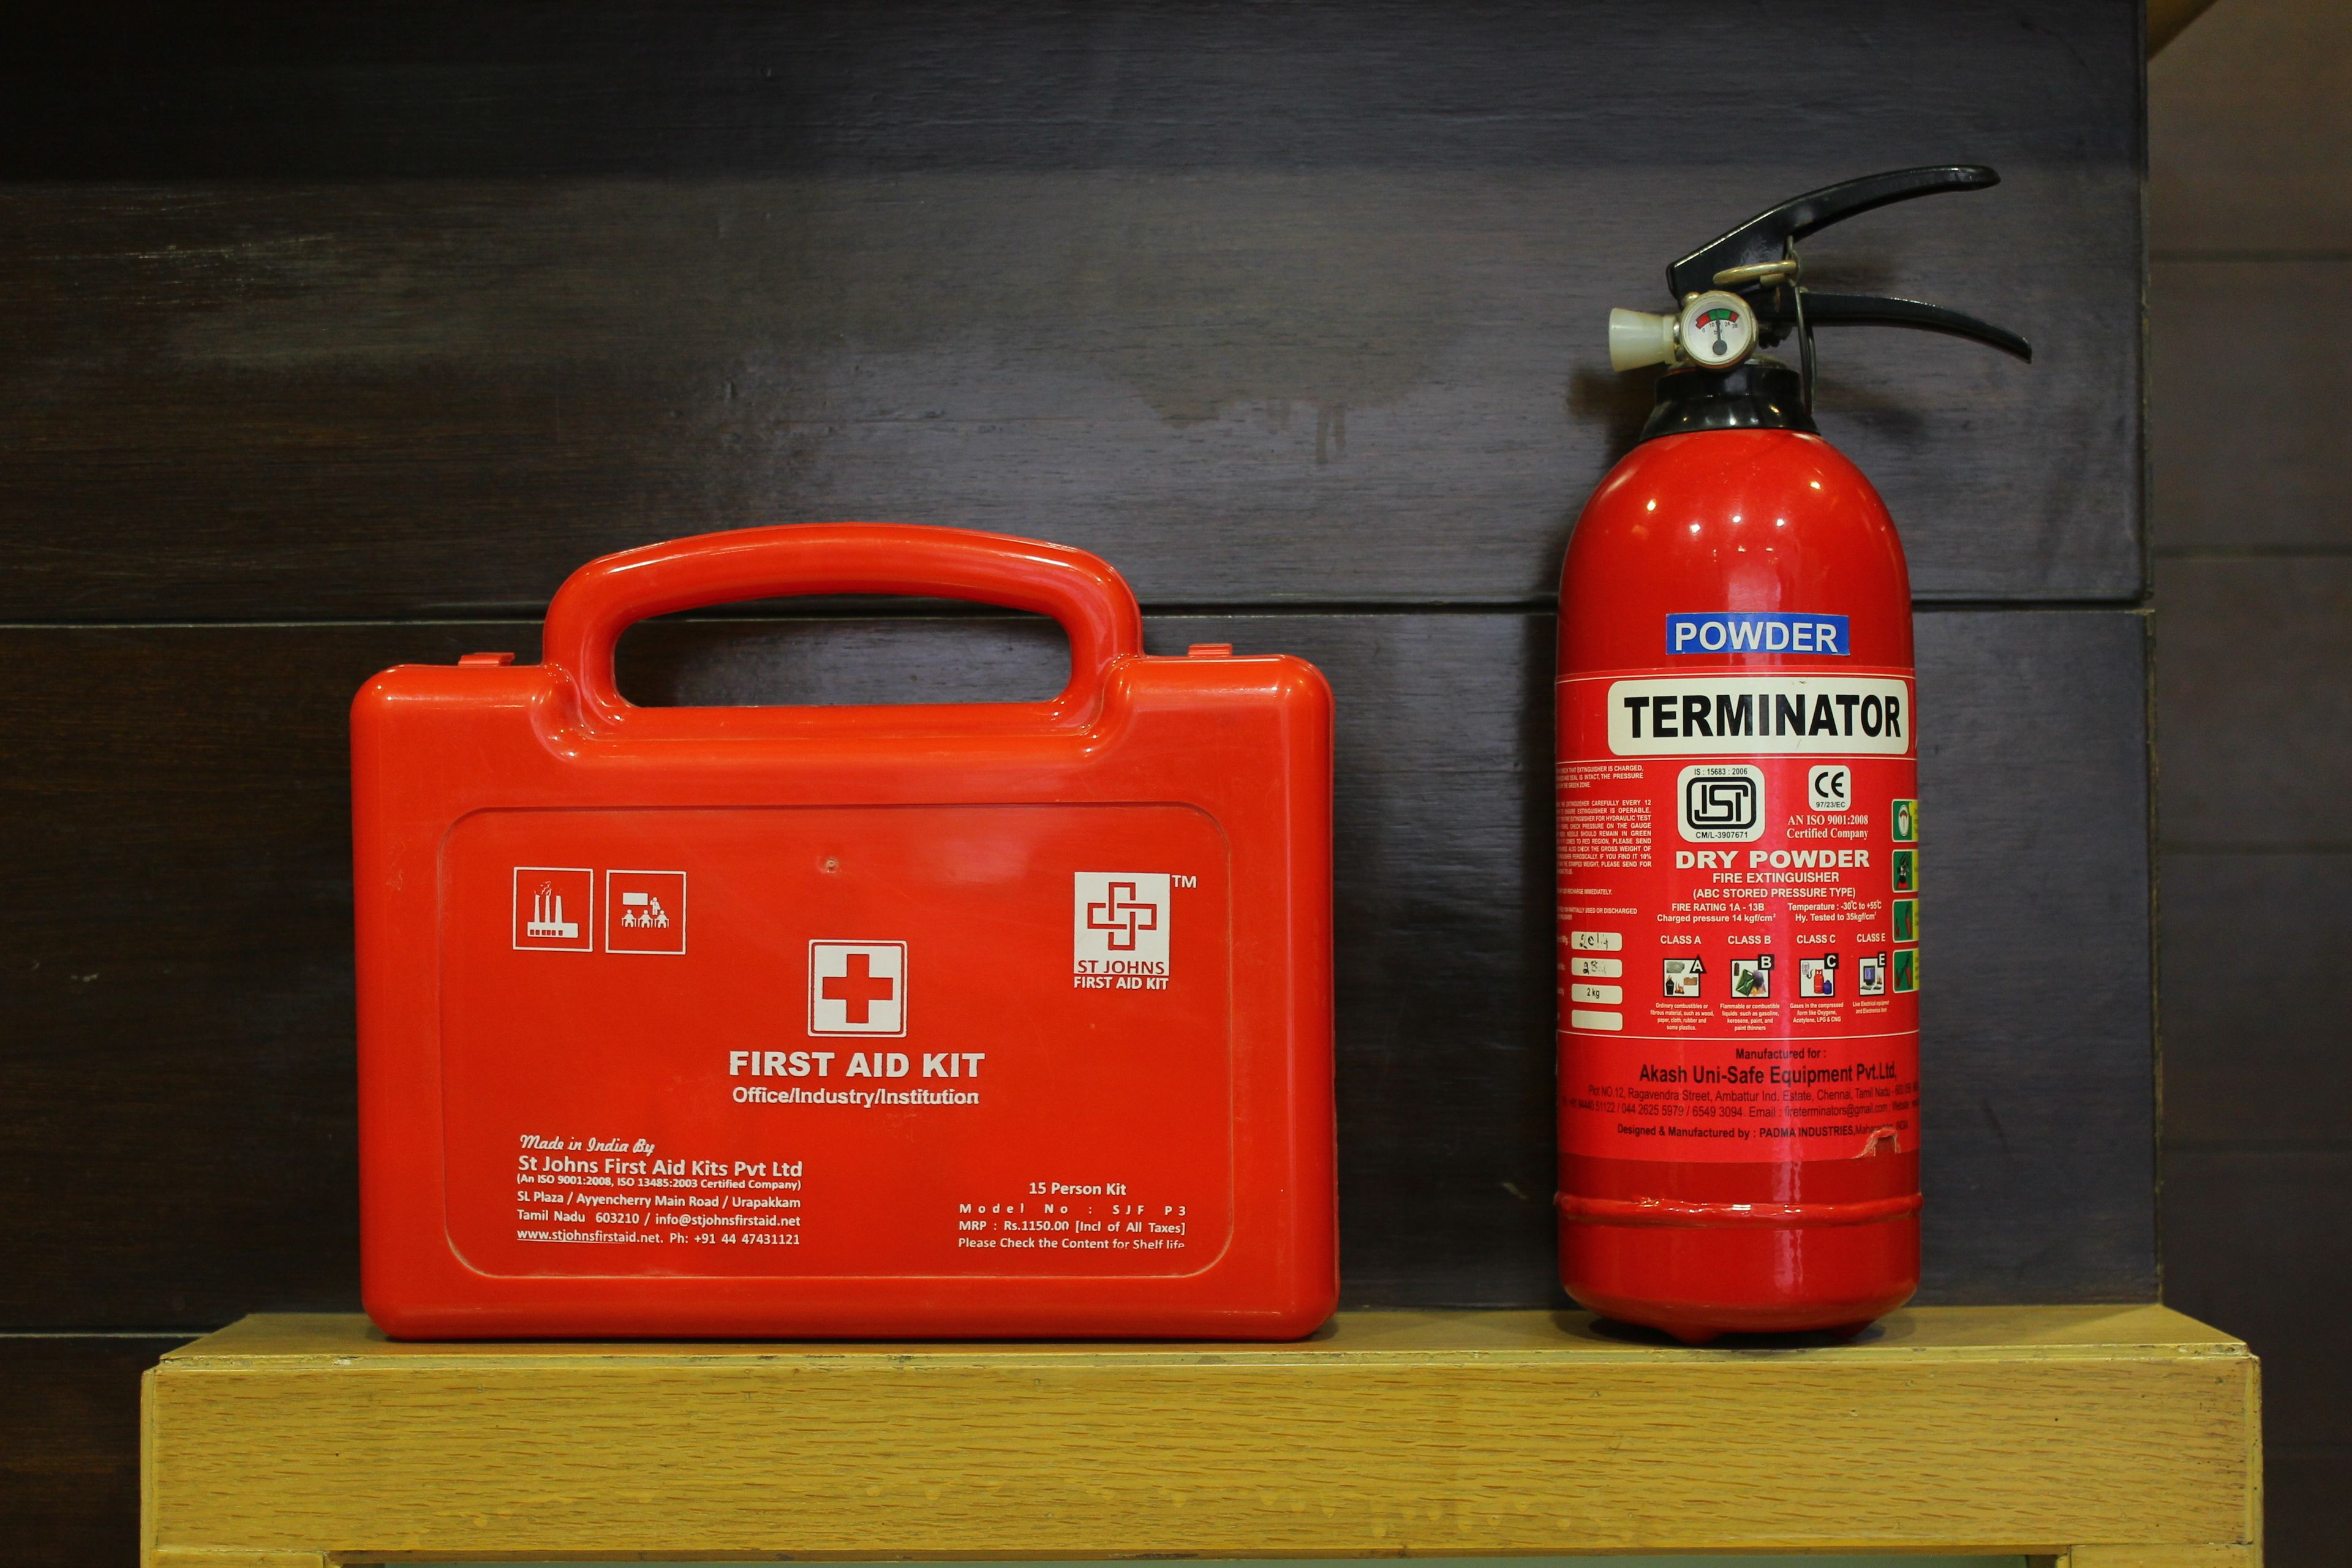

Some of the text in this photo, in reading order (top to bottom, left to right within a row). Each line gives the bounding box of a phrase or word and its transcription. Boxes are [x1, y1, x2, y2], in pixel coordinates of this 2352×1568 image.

[1675, 620, 1839, 653] POWDER
[1624, 693, 1902, 739] TERMINATOR
[1814, 771, 1844, 798] CE
[1787, 815, 1869, 826] AN ISO 9001:2008
[1786, 828, 1869, 841] Certified Company
[1676, 850, 1871, 869] DRY POWDER
[1171, 875, 1197, 888] TM
[1713, 872, 1839, 884] FIRE EXTINGUISHER
[1693, 887, 1856, 900] (ABC STORED PRESSURE TYPE)
[1672, 903, 1765, 911] FIRE RATING 1A 13B
[1787, 902, 1835, 912] Temperature
[1858, 902, 1866, 910] to
[1657, 914, 1742, 924] Charged pressure 14
[1795, 913, 1808, 924] Hy.
[1810, 913, 1836, 922] Tested
[1660, 935, 1702, 945] CLASS A
[1727, 935, 1771, 945] CLASS B
[1796, 933, 1836, 944] CLASS C
[1856, 932, 1885, 943] CLASS E
[1761, 956, 1771, 968] B
[1826, 956, 1836, 968] C
[1879, 953, 1886, 966] E
[1077, 960, 1164, 974] ST JOHNS
[1692, 961, 1703, 972] A
[1074, 976, 1169, 990] FIRST AID KIT
[1586, 987, 1600, 1000] 2 kg
[1735, 1048, 1821, 1060] Manufactured for
[729, 1050, 986, 1078] FIRST AID KIT
[1640, 1064, 1687, 1083] Akash
[1692, 1065, 1764, 1084] Uni-Safe
[1770, 1063, 1853, 1087] Equipment
[733, 1085, 980, 1109] Office/Industry/Institution
[1628, 1087, 1873, 1102] Ragavendra Street, Ambattur Ind. Estate, Chennai, Tamil
[1623, 1103, 1636, 1114] 044
[1638, 1104, 1659, 1115] 2625
[1661, 1104, 1684, 1117] 5979
[1692, 1105, 1716, 1117] 6549
[1749, 1106, 1776, 1118] Email
[1617, 1123, 1656, 1137] Designed
[1668, 1126, 1735, 1138] Manufactured
[1738, 1127, 1749, 1140] by
[1759, 1127, 1796, 1138] PADMA
[520, 1134, 655, 1157] Made in India By
[518, 1155, 803, 1178] St Johns First Aid Kits Pvt Ltd
[517, 1173, 802, 1191] (An ISO 9001:2008, ISO 13485:2003 Certified Company)
[1029, 1182, 1127, 1196] 15 Person Kit
[517, 1190, 801, 1210] SL Plaza Ayyencherry Main Road Urapakkam
[517, 1208, 801, 1228] Tamil Nadu 603210 info@stjohnsfirstaid.net
[959, 1220, 1186, 1235] MRP Rs.1150.00 [Incl of All Taxes]
[669, 1232, 688, 1243] Ph:
[694, 1233, 716, 1244] +91
[721, 1234, 737, 1245] 44
[741, 1233, 801, 1245] 47431121
[959, 1237, 1186, 1250] Please Check the Content for Shelf life
